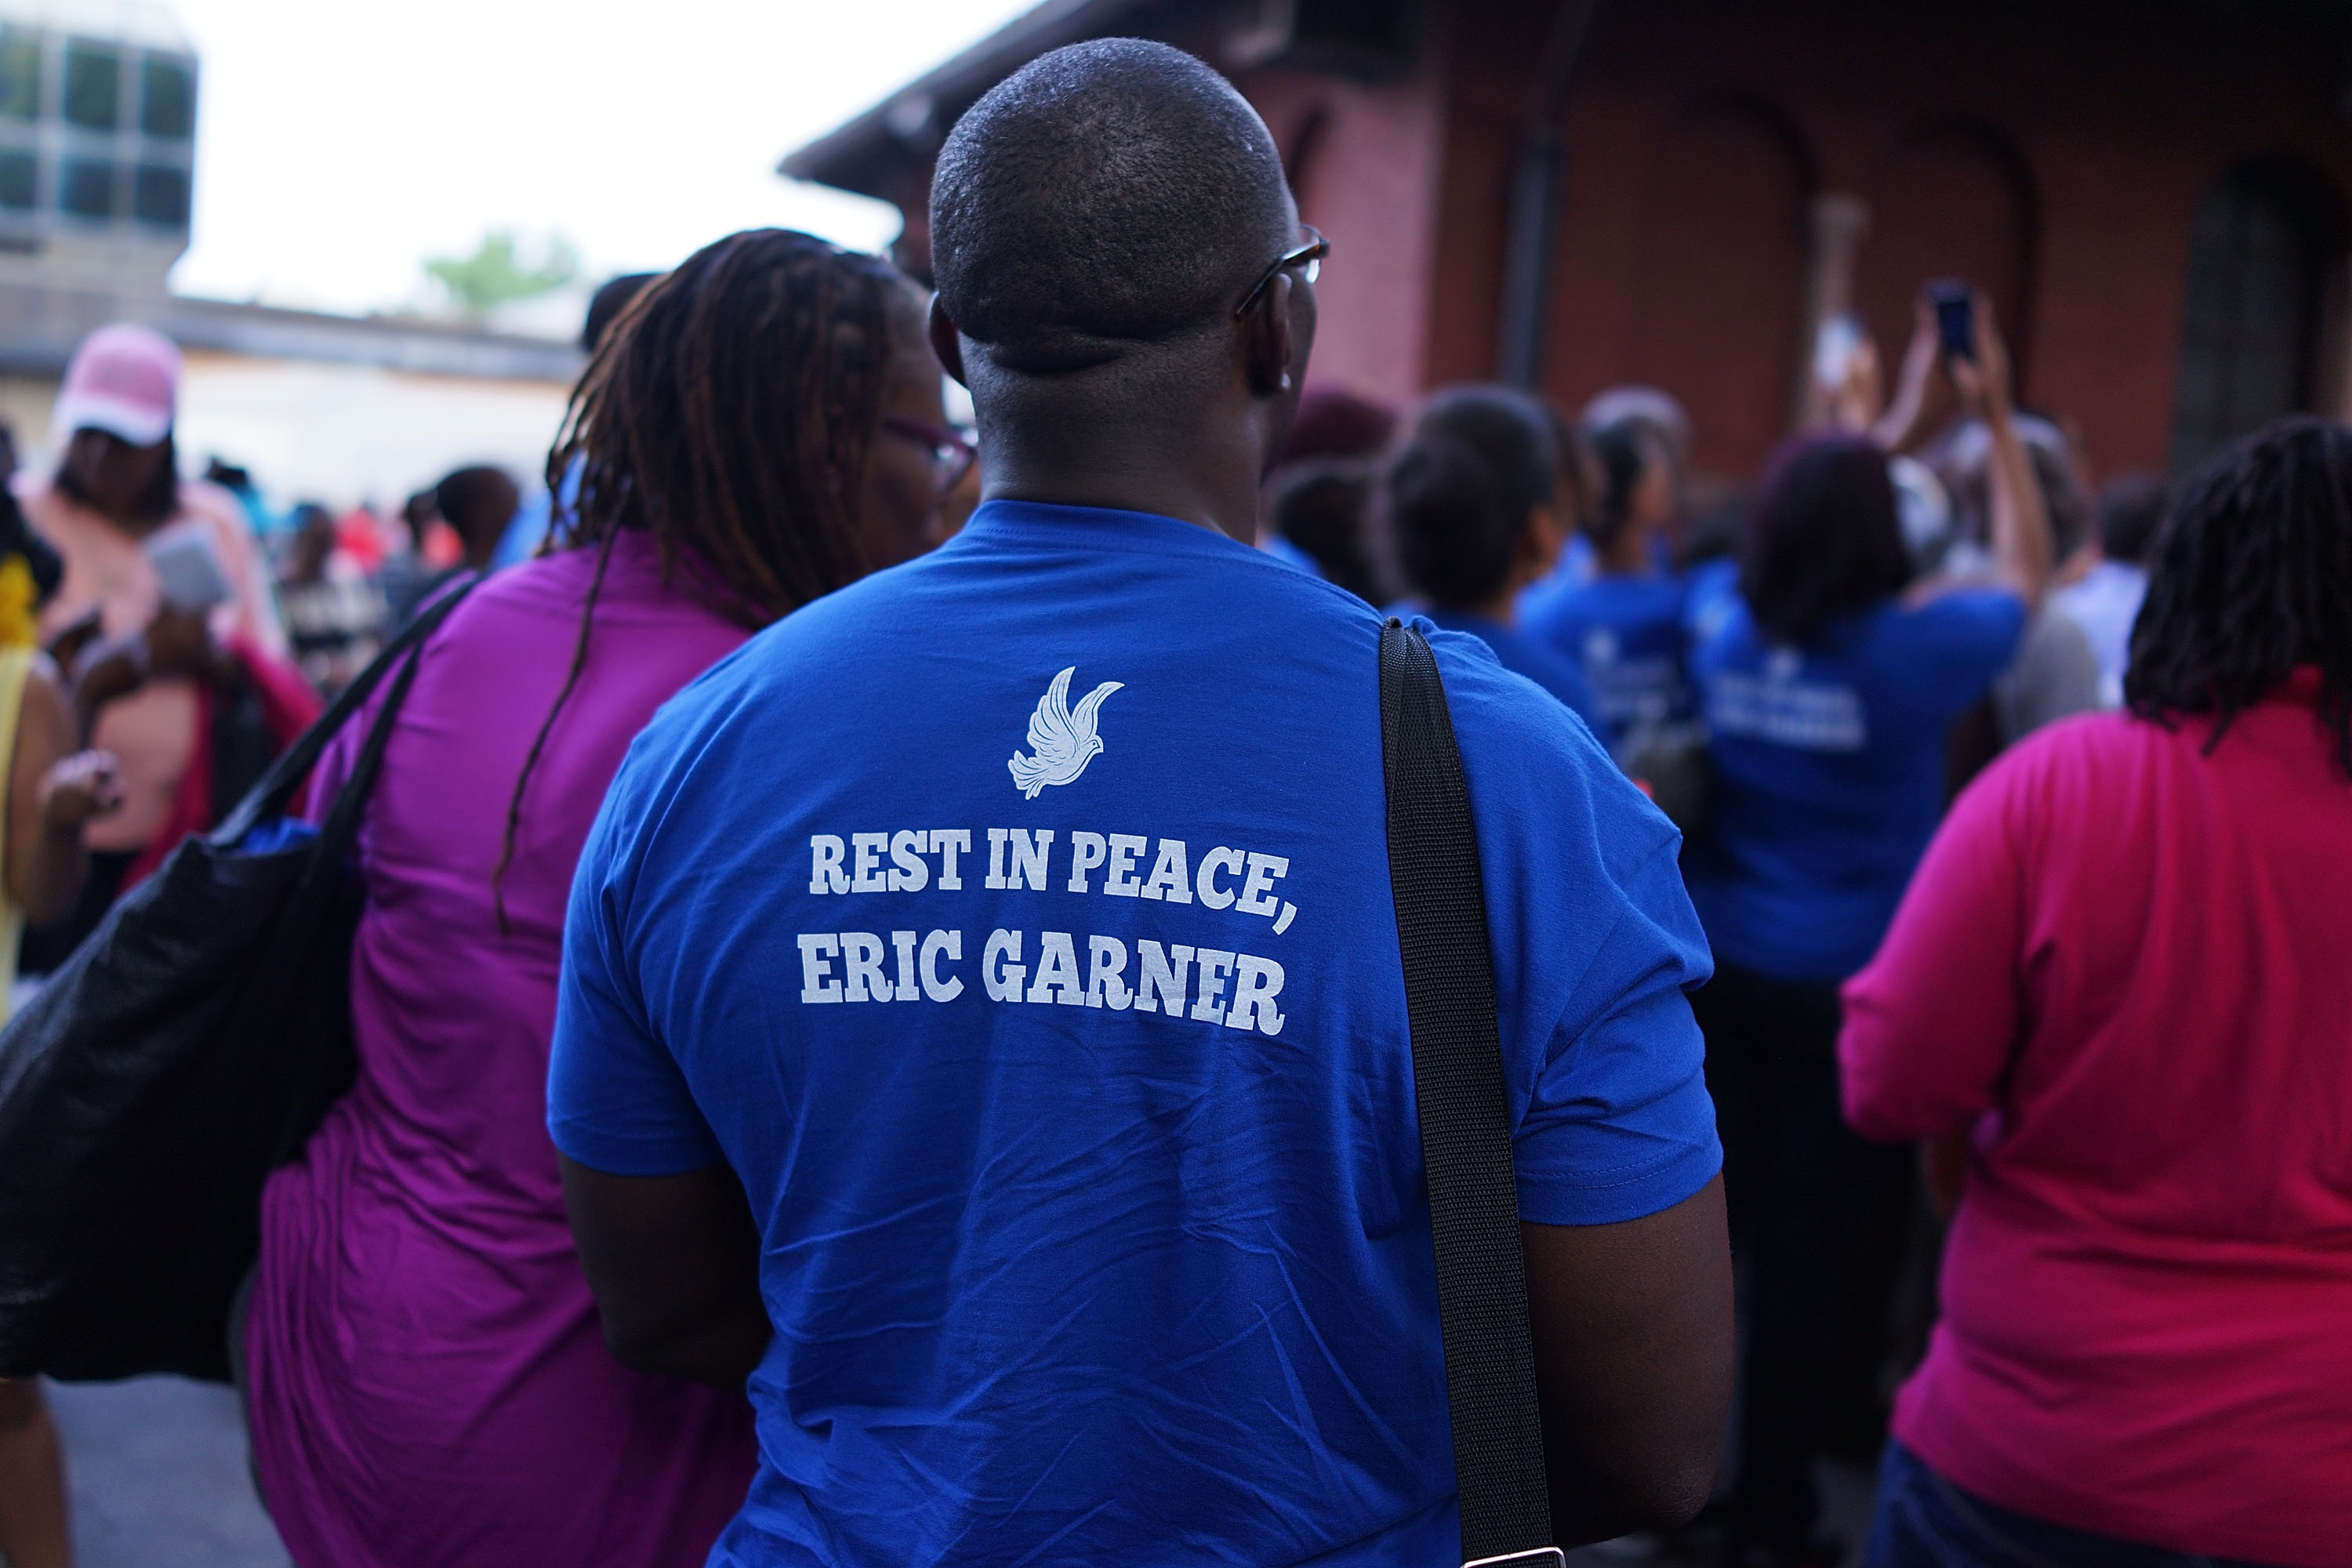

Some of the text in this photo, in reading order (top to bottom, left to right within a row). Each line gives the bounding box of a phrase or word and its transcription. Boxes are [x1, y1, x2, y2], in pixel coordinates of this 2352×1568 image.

[810, 828, 1298, 935] REST IN PEACE,
[797, 928, 1286, 1036] ERIC GARNER
